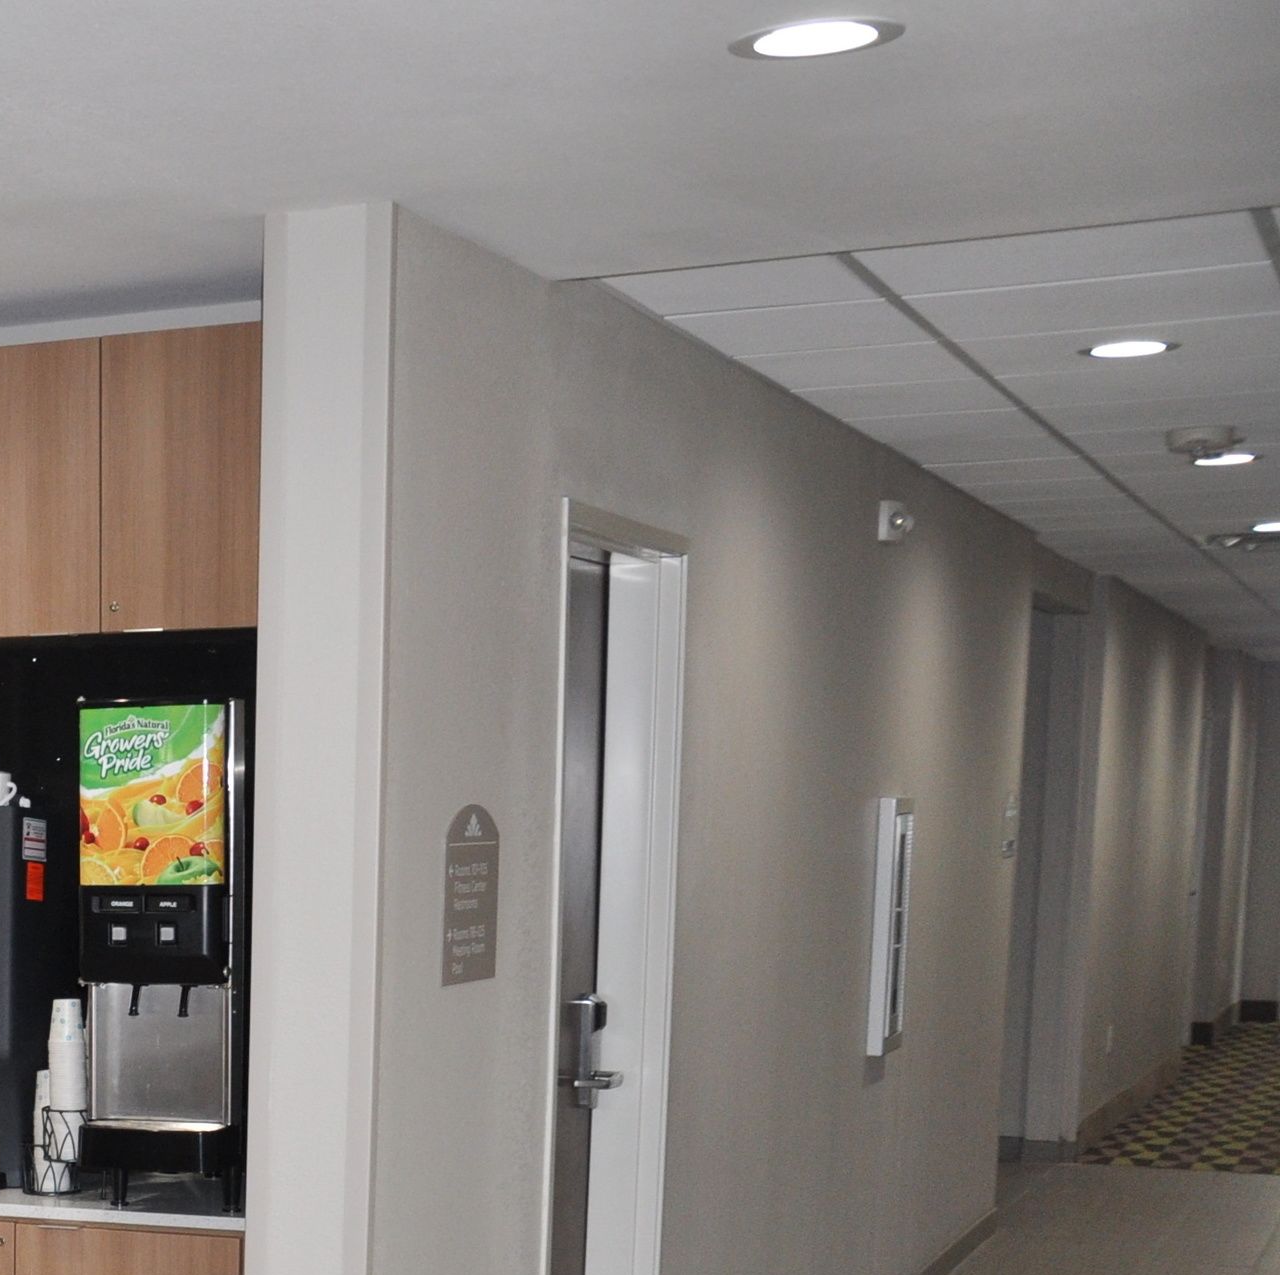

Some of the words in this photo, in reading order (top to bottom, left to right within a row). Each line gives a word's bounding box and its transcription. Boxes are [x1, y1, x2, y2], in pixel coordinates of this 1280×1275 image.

[137, 719, 169, 730] Natural
[84, 731, 170, 760] Growers'
[98, 748, 152, 779] Pride
